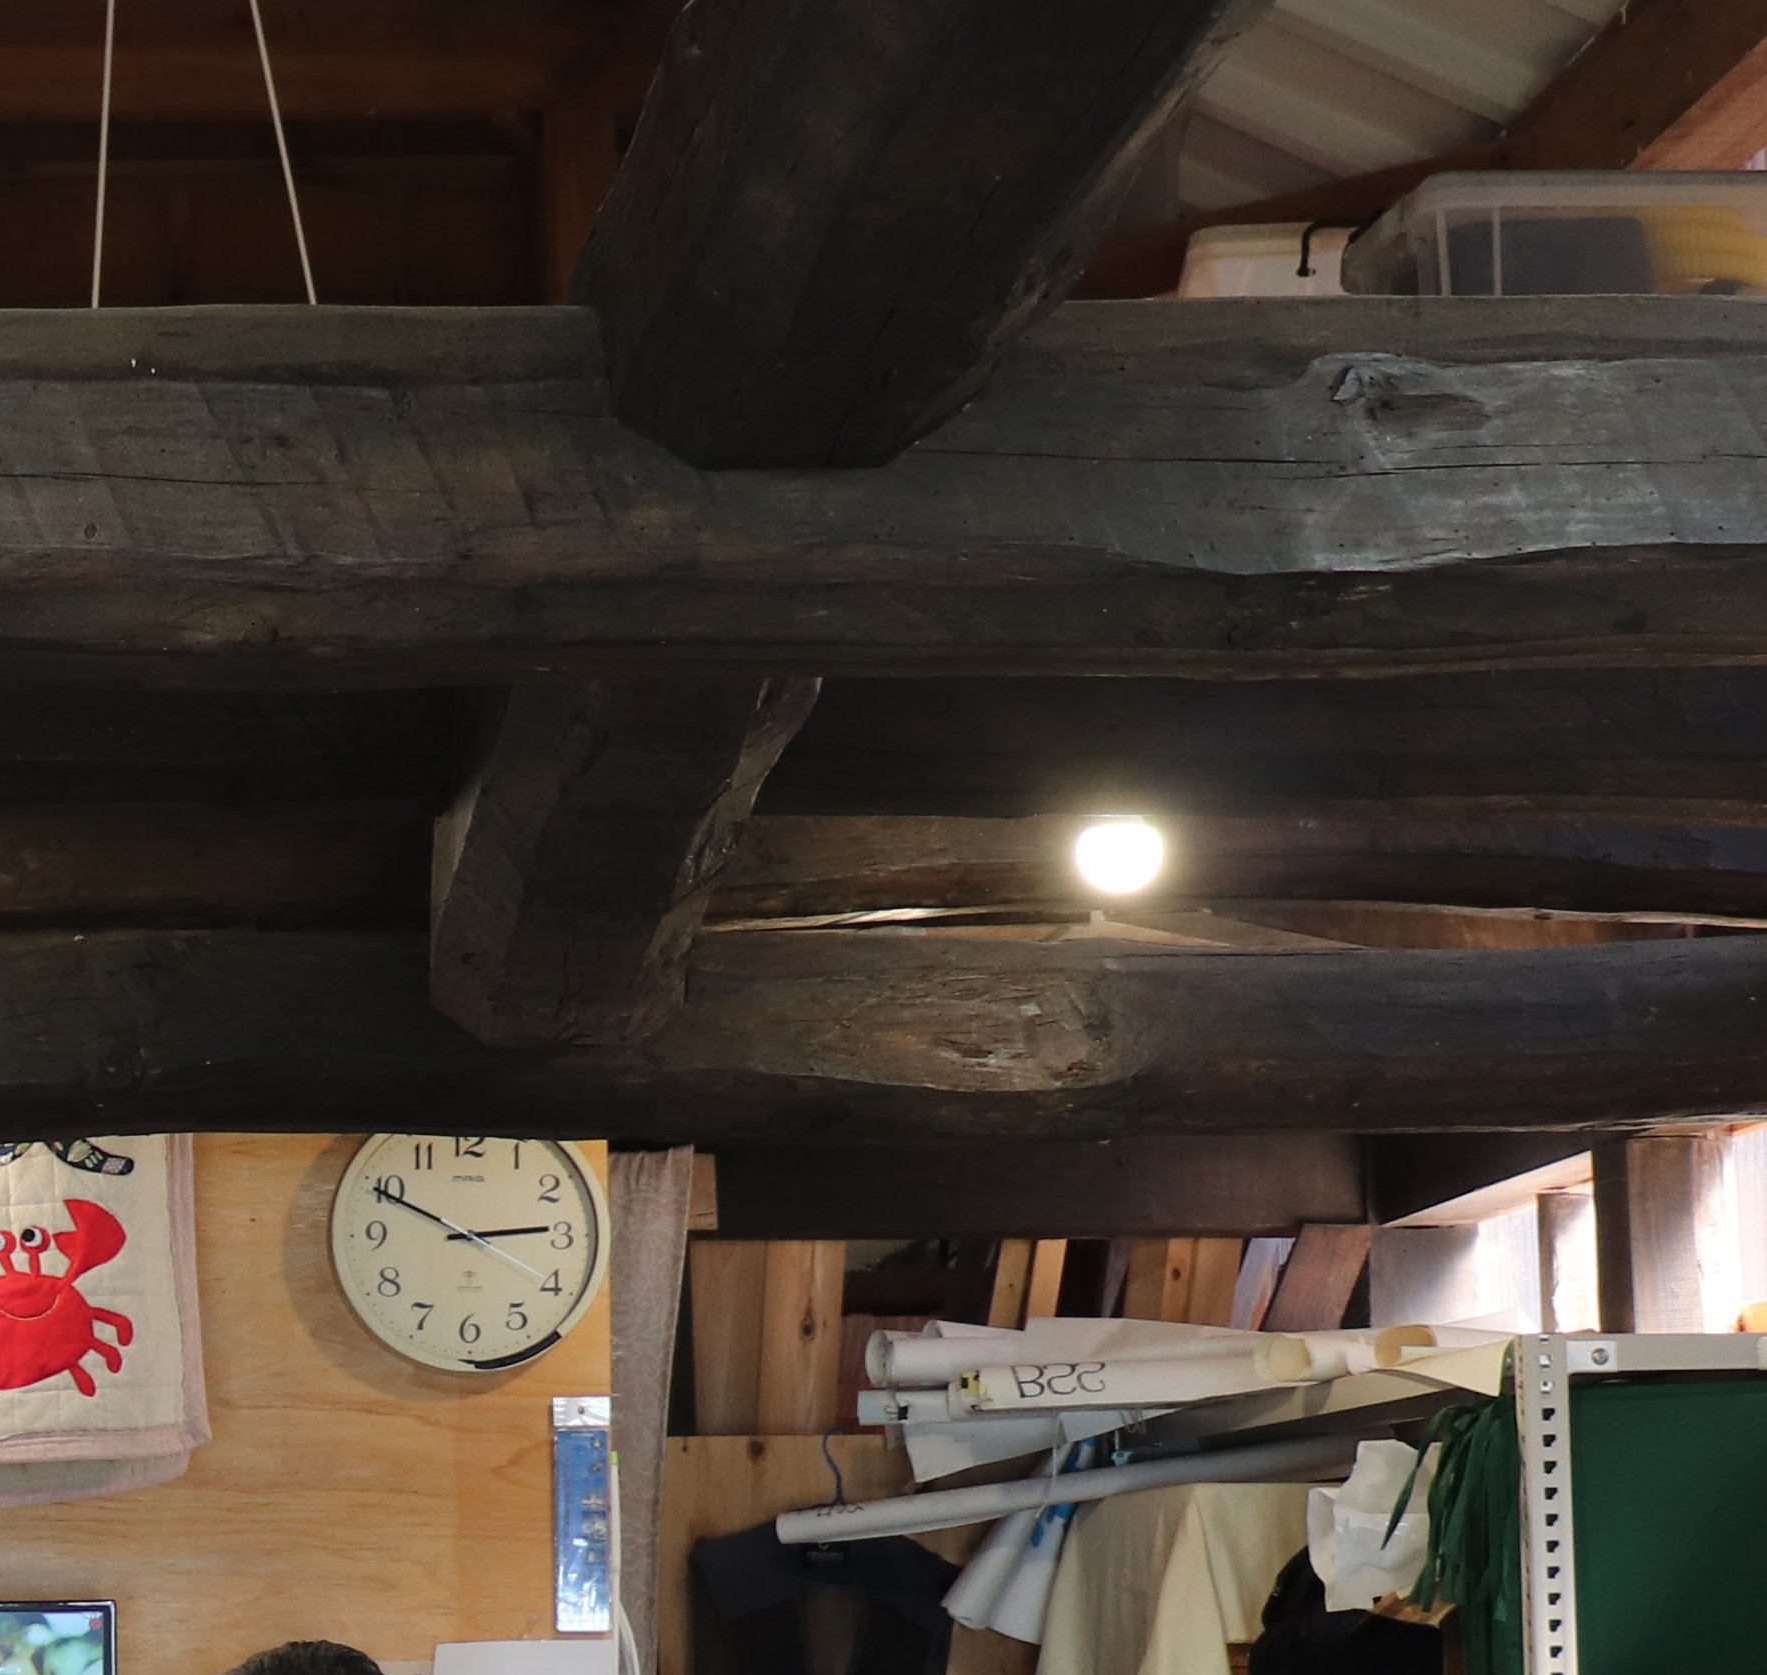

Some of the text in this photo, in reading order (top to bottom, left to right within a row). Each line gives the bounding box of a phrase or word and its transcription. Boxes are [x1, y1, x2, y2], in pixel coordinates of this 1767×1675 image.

[415, 1142, 434, 1170] 11
[538, 1173, 561, 1204] 2
[365, 1220, 574, 1250] 9 3
[377, 1267, 563, 1297] 8 4
[410, 1301, 529, 1344] 7 6 5
